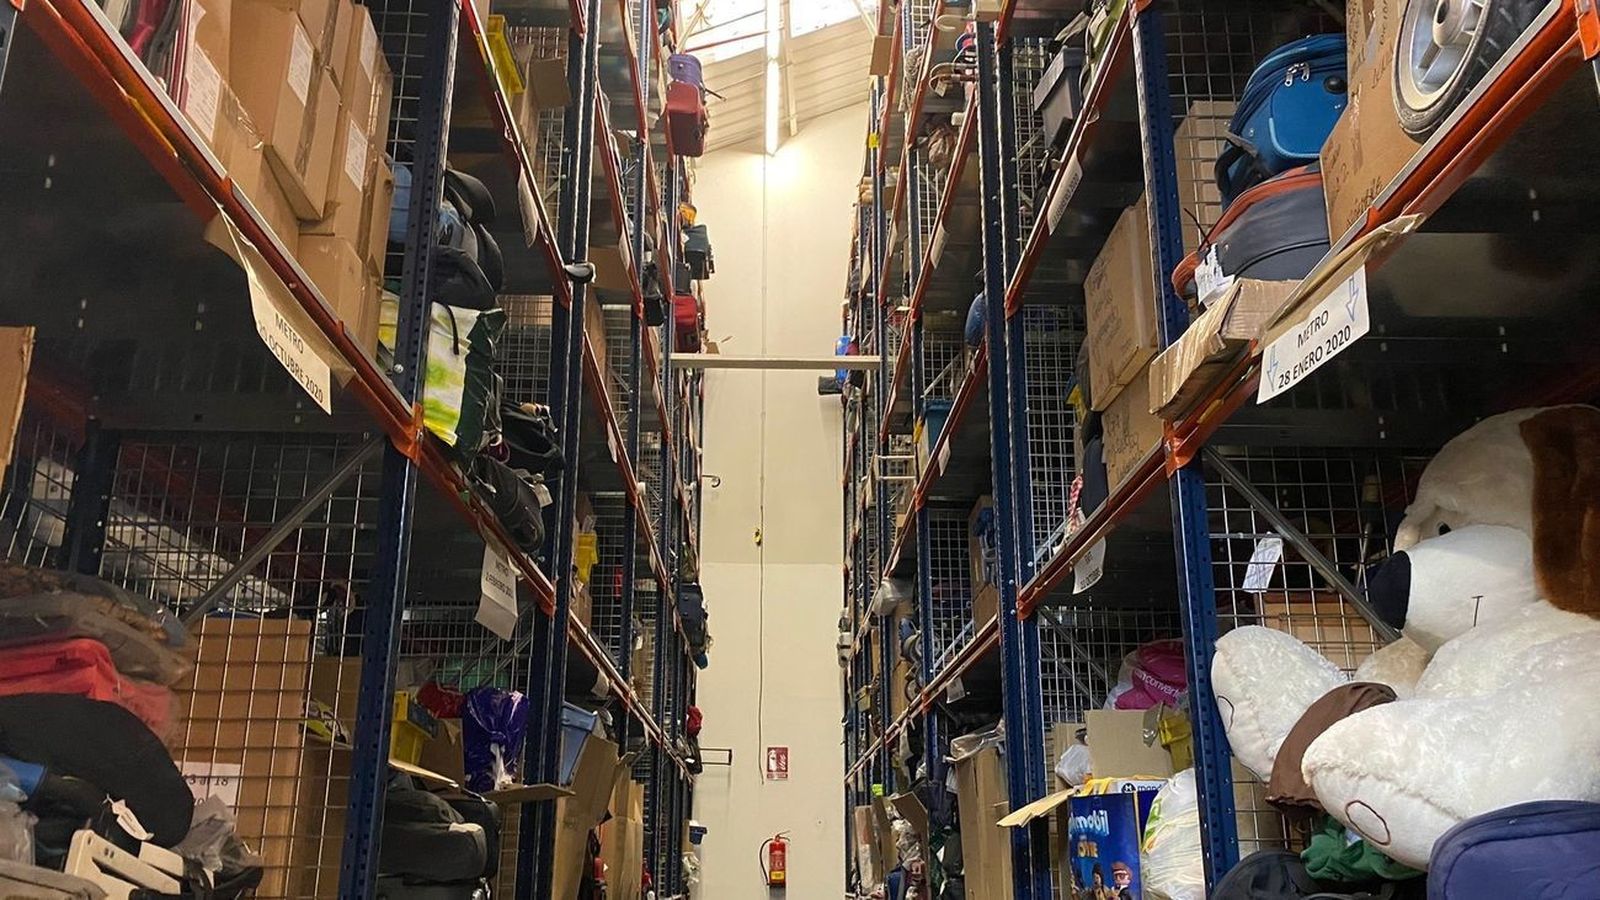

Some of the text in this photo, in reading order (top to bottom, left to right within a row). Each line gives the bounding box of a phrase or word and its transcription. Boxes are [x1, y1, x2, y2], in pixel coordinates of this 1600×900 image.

[274, 312, 304, 354] METRO
[1297, 309, 1329, 348] METRO
[268, 335, 304, 384] OCTUBRE
[304, 374, 324, 404] 2020
[1278, 324, 1351, 389] 28 ENERO 2020
